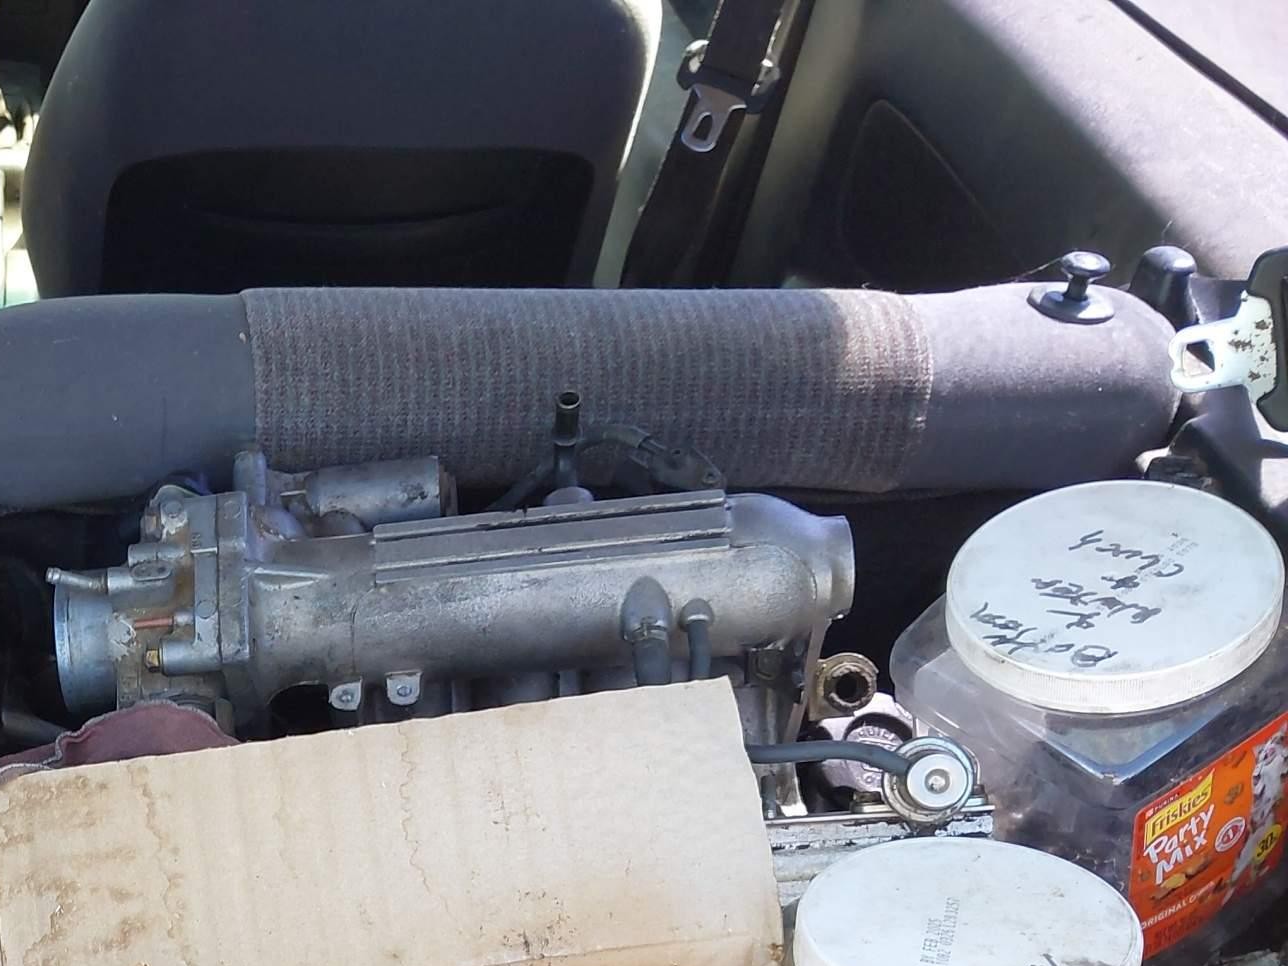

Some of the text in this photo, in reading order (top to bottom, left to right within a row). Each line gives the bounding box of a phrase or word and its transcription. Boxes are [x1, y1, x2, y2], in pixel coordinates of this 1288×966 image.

[1143, 804, 1214, 864] Party
[1151, 790, 1209, 838] Friskies
[1155, 831, 1207, 886] Mix
